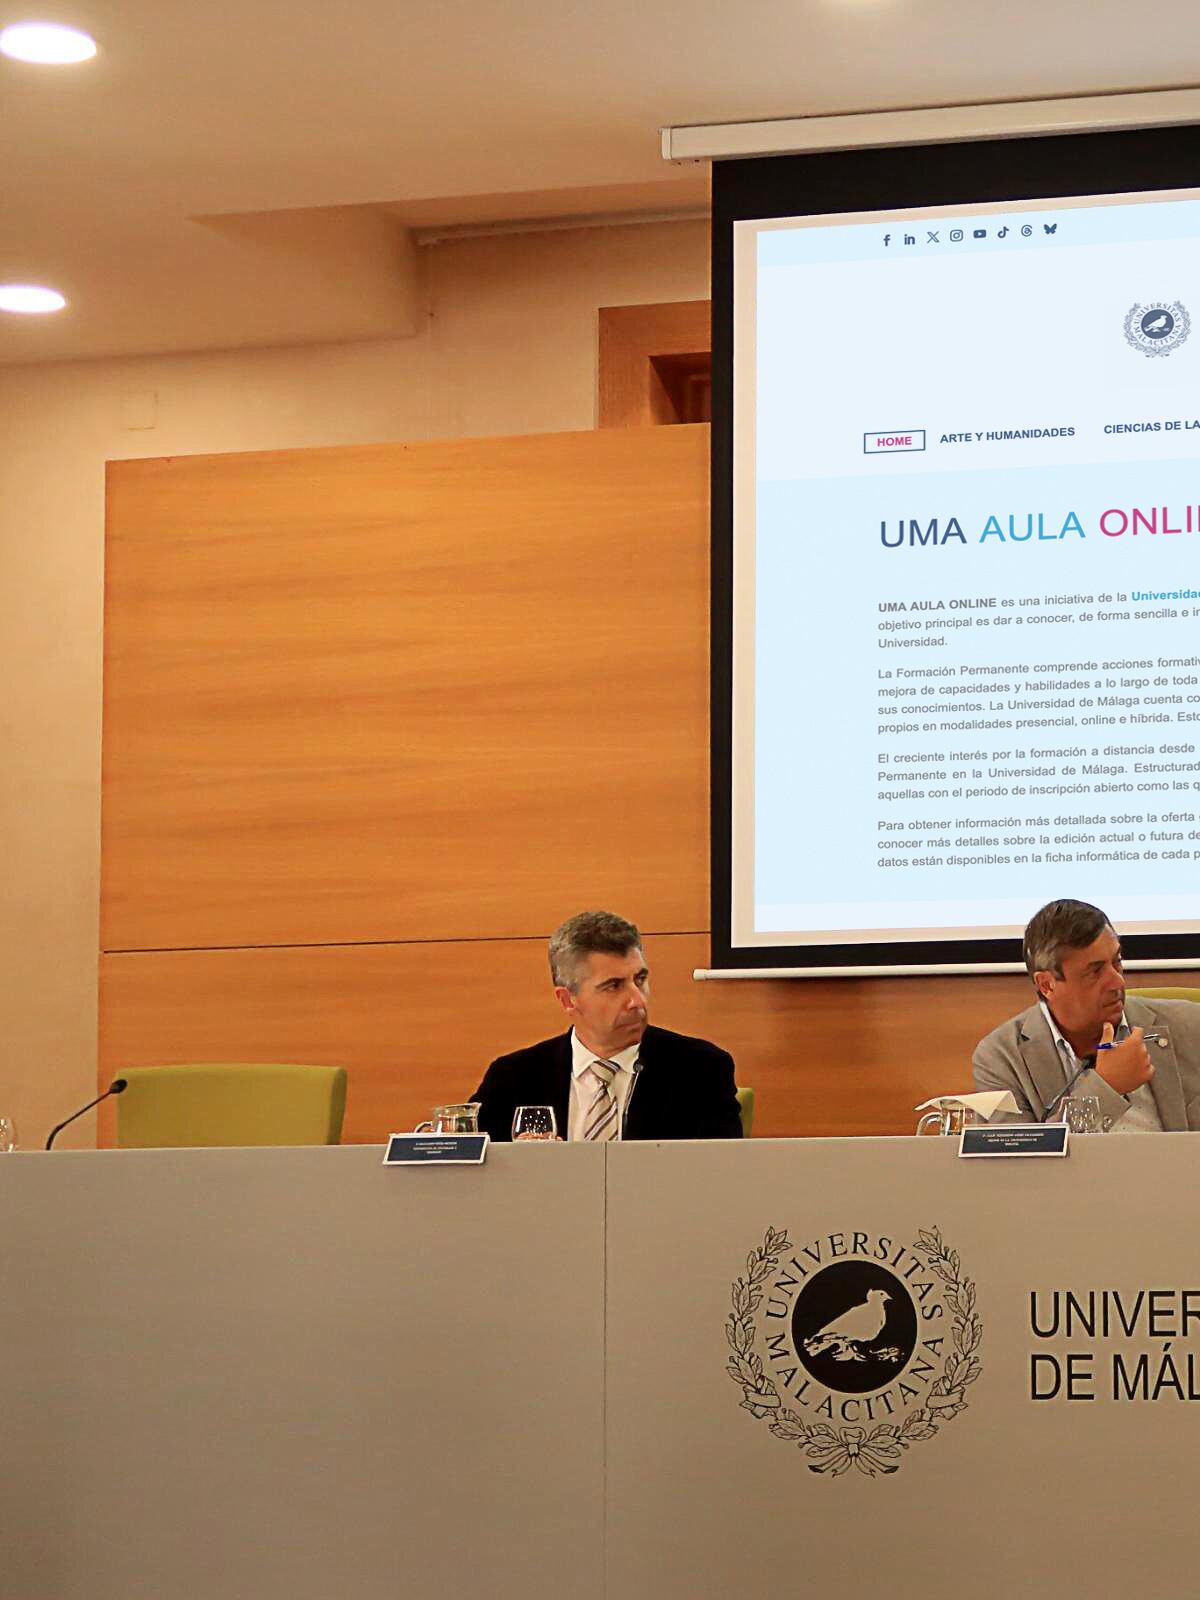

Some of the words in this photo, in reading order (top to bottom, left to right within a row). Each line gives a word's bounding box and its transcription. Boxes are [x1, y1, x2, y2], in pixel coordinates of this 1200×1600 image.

[939, 432, 973, 444] ARTE
[974, 431, 984, 442] Y
[985, 426, 1076, 441] HUMANIDADES
[1103, 421, 1162, 435] CIENCIAS
[1164, 420, 1182, 431] DE
[877, 436, 912, 447] HOME
[880, 517, 968, 549] UMA
[978, 511, 1087, 544] AULA
[878, 601, 908, 613] UMA
[909, 600, 946, 612] AULA
[948, 597, 997, 610] ONLINE
[1000, 599, 1015, 608] es
[1018, 598, 1041, 607] una
[1044, 593, 1094, 605] iniciativa
[1097, 592, 1113, 603] de
[1116, 591, 1128, 602] la
[877, 619, 922, 633] objetivo
[925, 616, 973, 631] principal
[975, 618, 990, 627] es
[992, 615, 1013, 626] dar
[1015, 616, 1023, 625] a
[1026, 614, 1075, 624] conocer,
[1078, 611, 1094, 622] de
[1096, 610, 1131, 621] forma
[1133, 608, 1178, 620] sencilla
[1181, 609, 1189, 618] e
[878, 635, 948, 649] Universidad.
[878, 669, 893, 679] La
[896, 666, 956, 678] Formación
[960, 664, 1030, 676] Permanente
[1033, 660, 1098, 674] comprende
[1101, 658, 1154, 671] acciones
[877, 753, 889, 764] El
[893, 752, 945, 764] creciente
[949, 749, 988, 761] interés
[992, 751, 1012, 762] por
[1015, 748, 1026, 759] la
[1030, 746, 1087, 759] formación
[1091, 747, 1099, 757] a
[1102, 744, 1155, 756] distancia
[1158, 743, 1196, 754] desde
[877, 820, 905, 831] Para
[907, 819, 952, 830] obtener
[955, 816, 1022, 829] información
[1025, 816, 1050, 827] más
[1053, 814, 1107, 826] detallada
[1110, 813, 1144, 824] sobre
[1146, 812, 1158, 823] la
[1160, 811, 1195, 823] oferta
[766, 1231, 944, 1321] UNIVERSITAS
[765, 1333, 945, 1422] MALACITANA
[1030, 1353, 1095, 1401] DE
